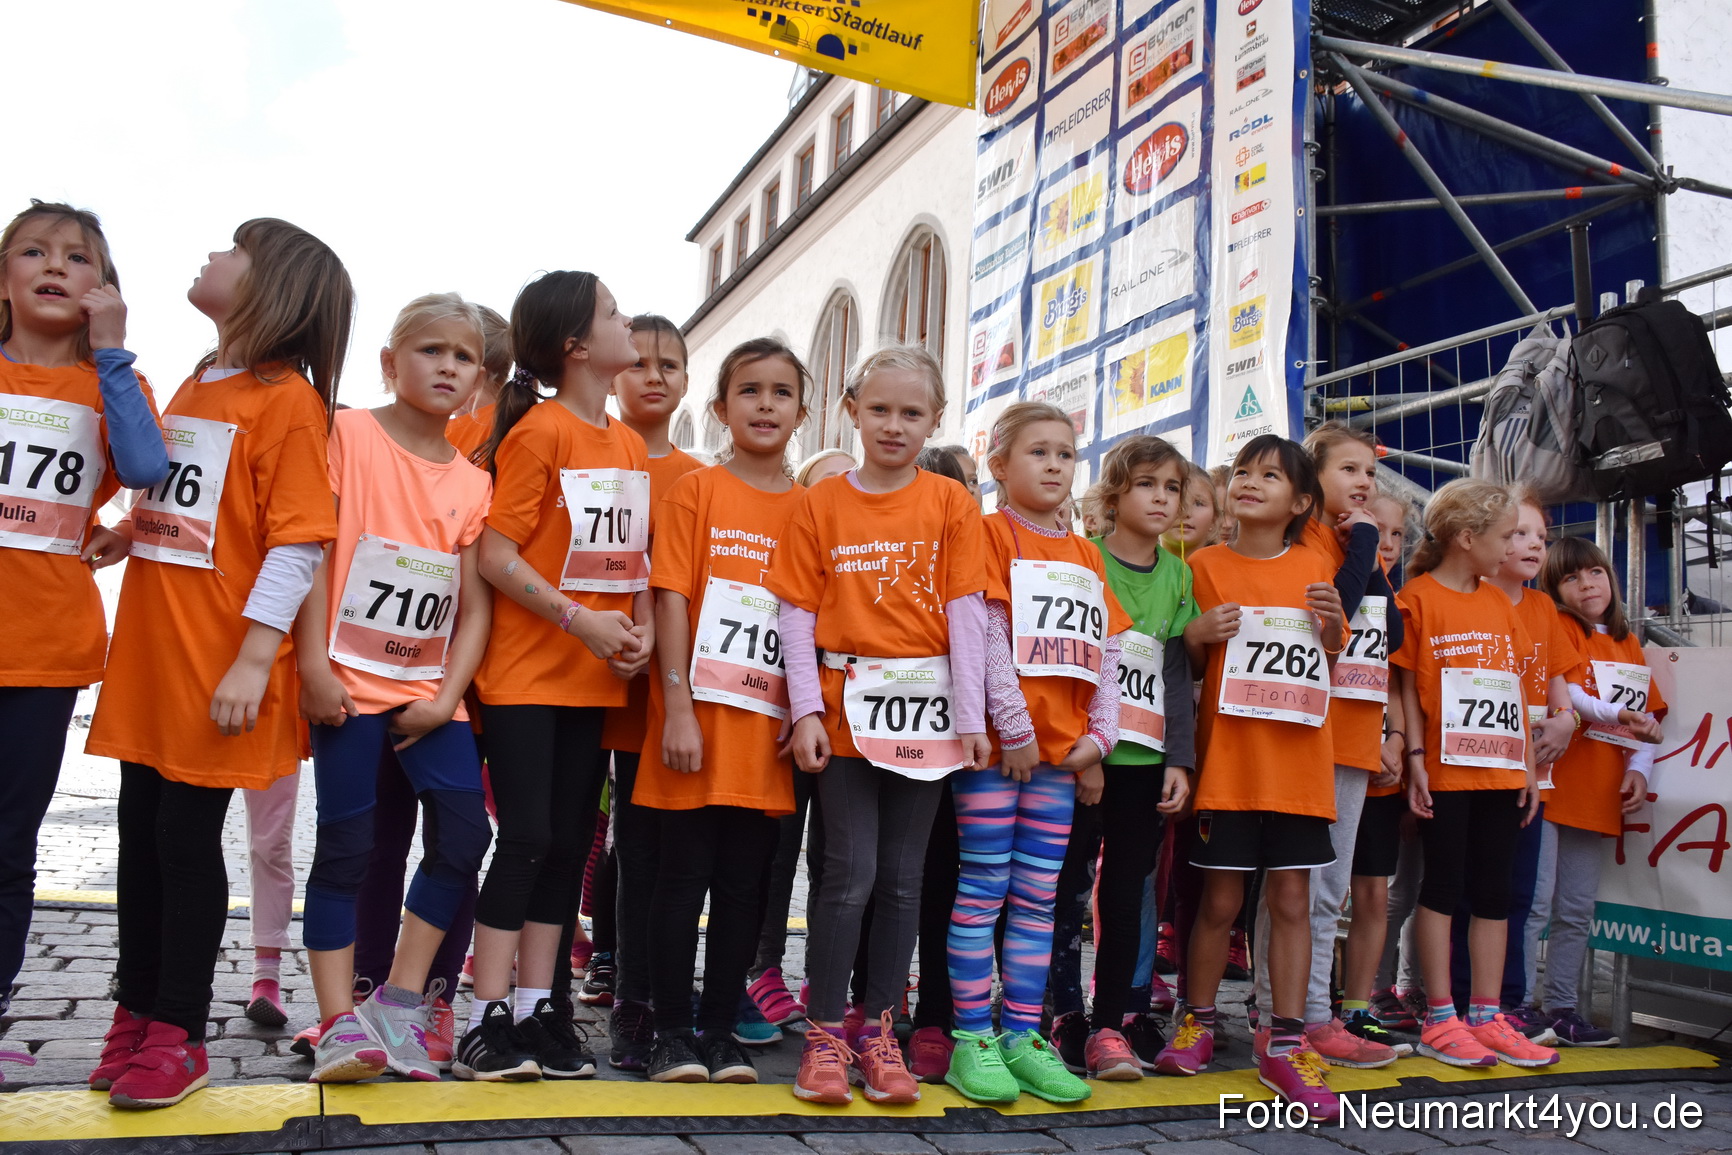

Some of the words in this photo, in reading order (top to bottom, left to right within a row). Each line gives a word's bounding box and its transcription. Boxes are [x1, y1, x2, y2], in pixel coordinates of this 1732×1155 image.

[830, 6, 924, 50] Stadtlauf
[1147, 6, 1195, 51] egner
[989, 66, 1027, 110] Hervis
[1053, 87, 1111, 142] PFLEIDERER
[1130, 134, 1182, 185] Hervis
[977, 158, 1015, 200] swn
[1233, 227, 1272, 251] PFLEIDERER
[1111, 262, 1165, 299] RAIL.ONE
[1226, 356, 1256, 376] swn
[1150, 374, 1183, 399] KANN
[9, 408, 70, 430] BOCK
[1236, 424, 1273, 440] VARIOTEC
[0, 440, 85, 496] 178
[135, 515, 180, 538] Magdalena
[584, 506, 632, 544] 7107
[605, 558, 627, 571] Tessa
[710, 543, 770, 565] Stadtlauf
[410, 558, 455, 578] BOCK
[1060, 572, 1092, 590] BOCK
[343, 608, 355, 618] B3
[365, 580, 453, 631] 7100
[1032, 595, 1103, 641] 7279
[1274, 617, 1313, 631] BOCK
[385, 640, 422, 659] Gloria
[699, 644, 710, 654] B3
[719, 617, 786, 671] 719
[1124, 640, 1154, 659] BOCK
[1430, 630, 1493, 647] Neumarkter
[1028, 637, 1095, 672] AMELIE
[1246, 641, 1321, 681] 7262
[1433, 643, 1483, 660] Stadtlauf
[741, 673, 769, 692] Julia
[896, 669, 936, 680] BOCK
[1483, 677, 1512, 690] BOCK
[1244, 683, 1311, 706] Fiona
[863, 695, 950, 733] 7073
[1458, 698, 1519, 733] 7248
[895, 745, 924, 759] Alise
[1457, 738, 1514, 757] FRANCA
